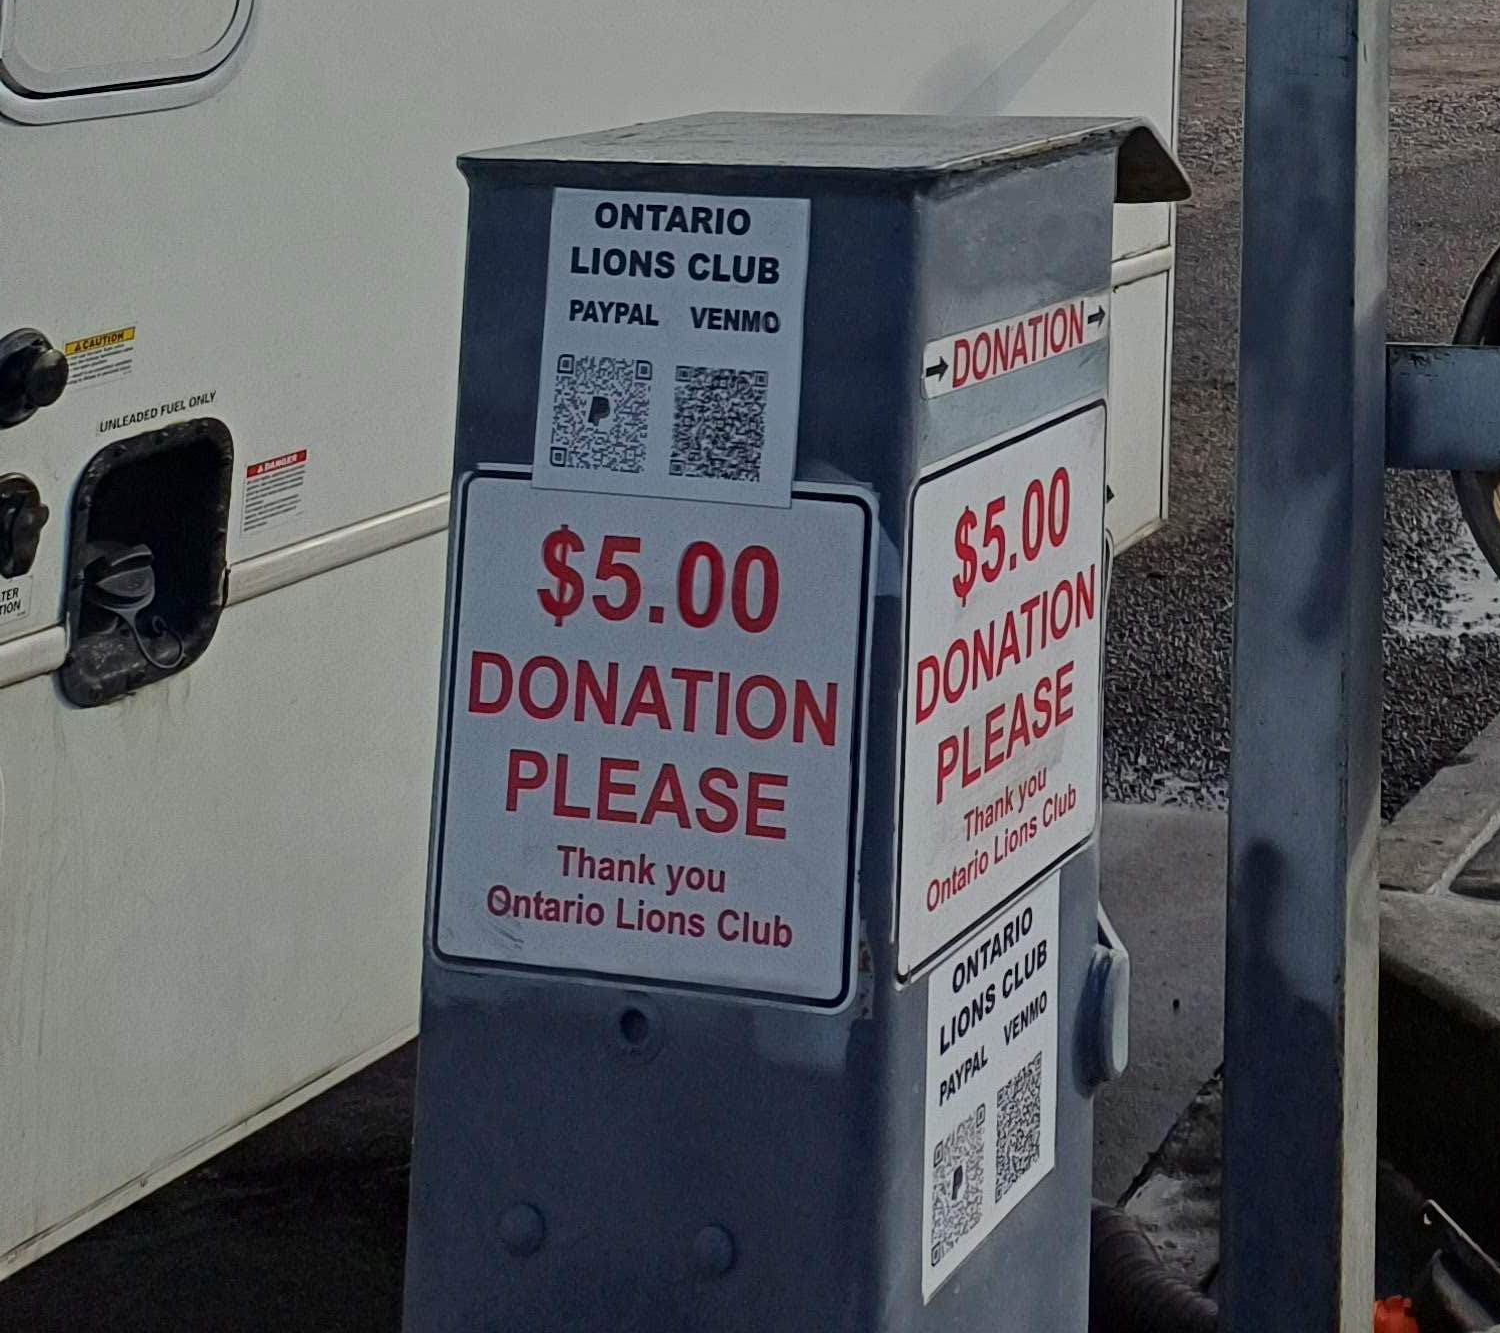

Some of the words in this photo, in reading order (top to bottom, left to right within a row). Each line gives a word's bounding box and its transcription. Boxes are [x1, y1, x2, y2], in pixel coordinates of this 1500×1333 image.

[595, 202, 751, 236] ONTARIO
[571, 247, 675, 281] LIONS
[687, 252, 780, 285] CLUB
[83, 331, 124, 350] CAUTION
[569, 300, 659, 328] PAYPAL
[691, 307, 780, 334] VENMO
[951, 301, 1085, 389] DONATION
[99, 408, 158, 433] UNLEADED
[160, 400, 186, 416] FUEL
[188, 390, 217, 408] ONLY
[537, 525, 779, 633] $5.00
[953, 467, 1070, 607] $5.00
[916, 564, 1096, 725] DONATION
[467, 652, 839, 747] DONATION
[936, 661, 1075, 805] PLEASE
[506, 749, 789, 840] PLEASE
[964, 790, 1011, 844] Thank
[1017, 766, 1047, 814] you
[557, 845, 656, 886] Thank
[666, 864, 726, 894] you
[926, 849, 989, 913] Ontario
[993, 814, 1037, 867] Lions
[1044, 785, 1076, 833] Club
[487, 886, 604, 927] Ontario
[616, 900, 705, 938] Lions
[718, 909, 792, 949] Club
[952, 907, 1033, 993] ONTARIO
[940, 983, 995, 1056] LIONS
[1002, 940, 1048, 999] CLUB
[939, 1046, 988, 1106] PAYPAL
[1003, 990, 1048, 1046] VENMO
